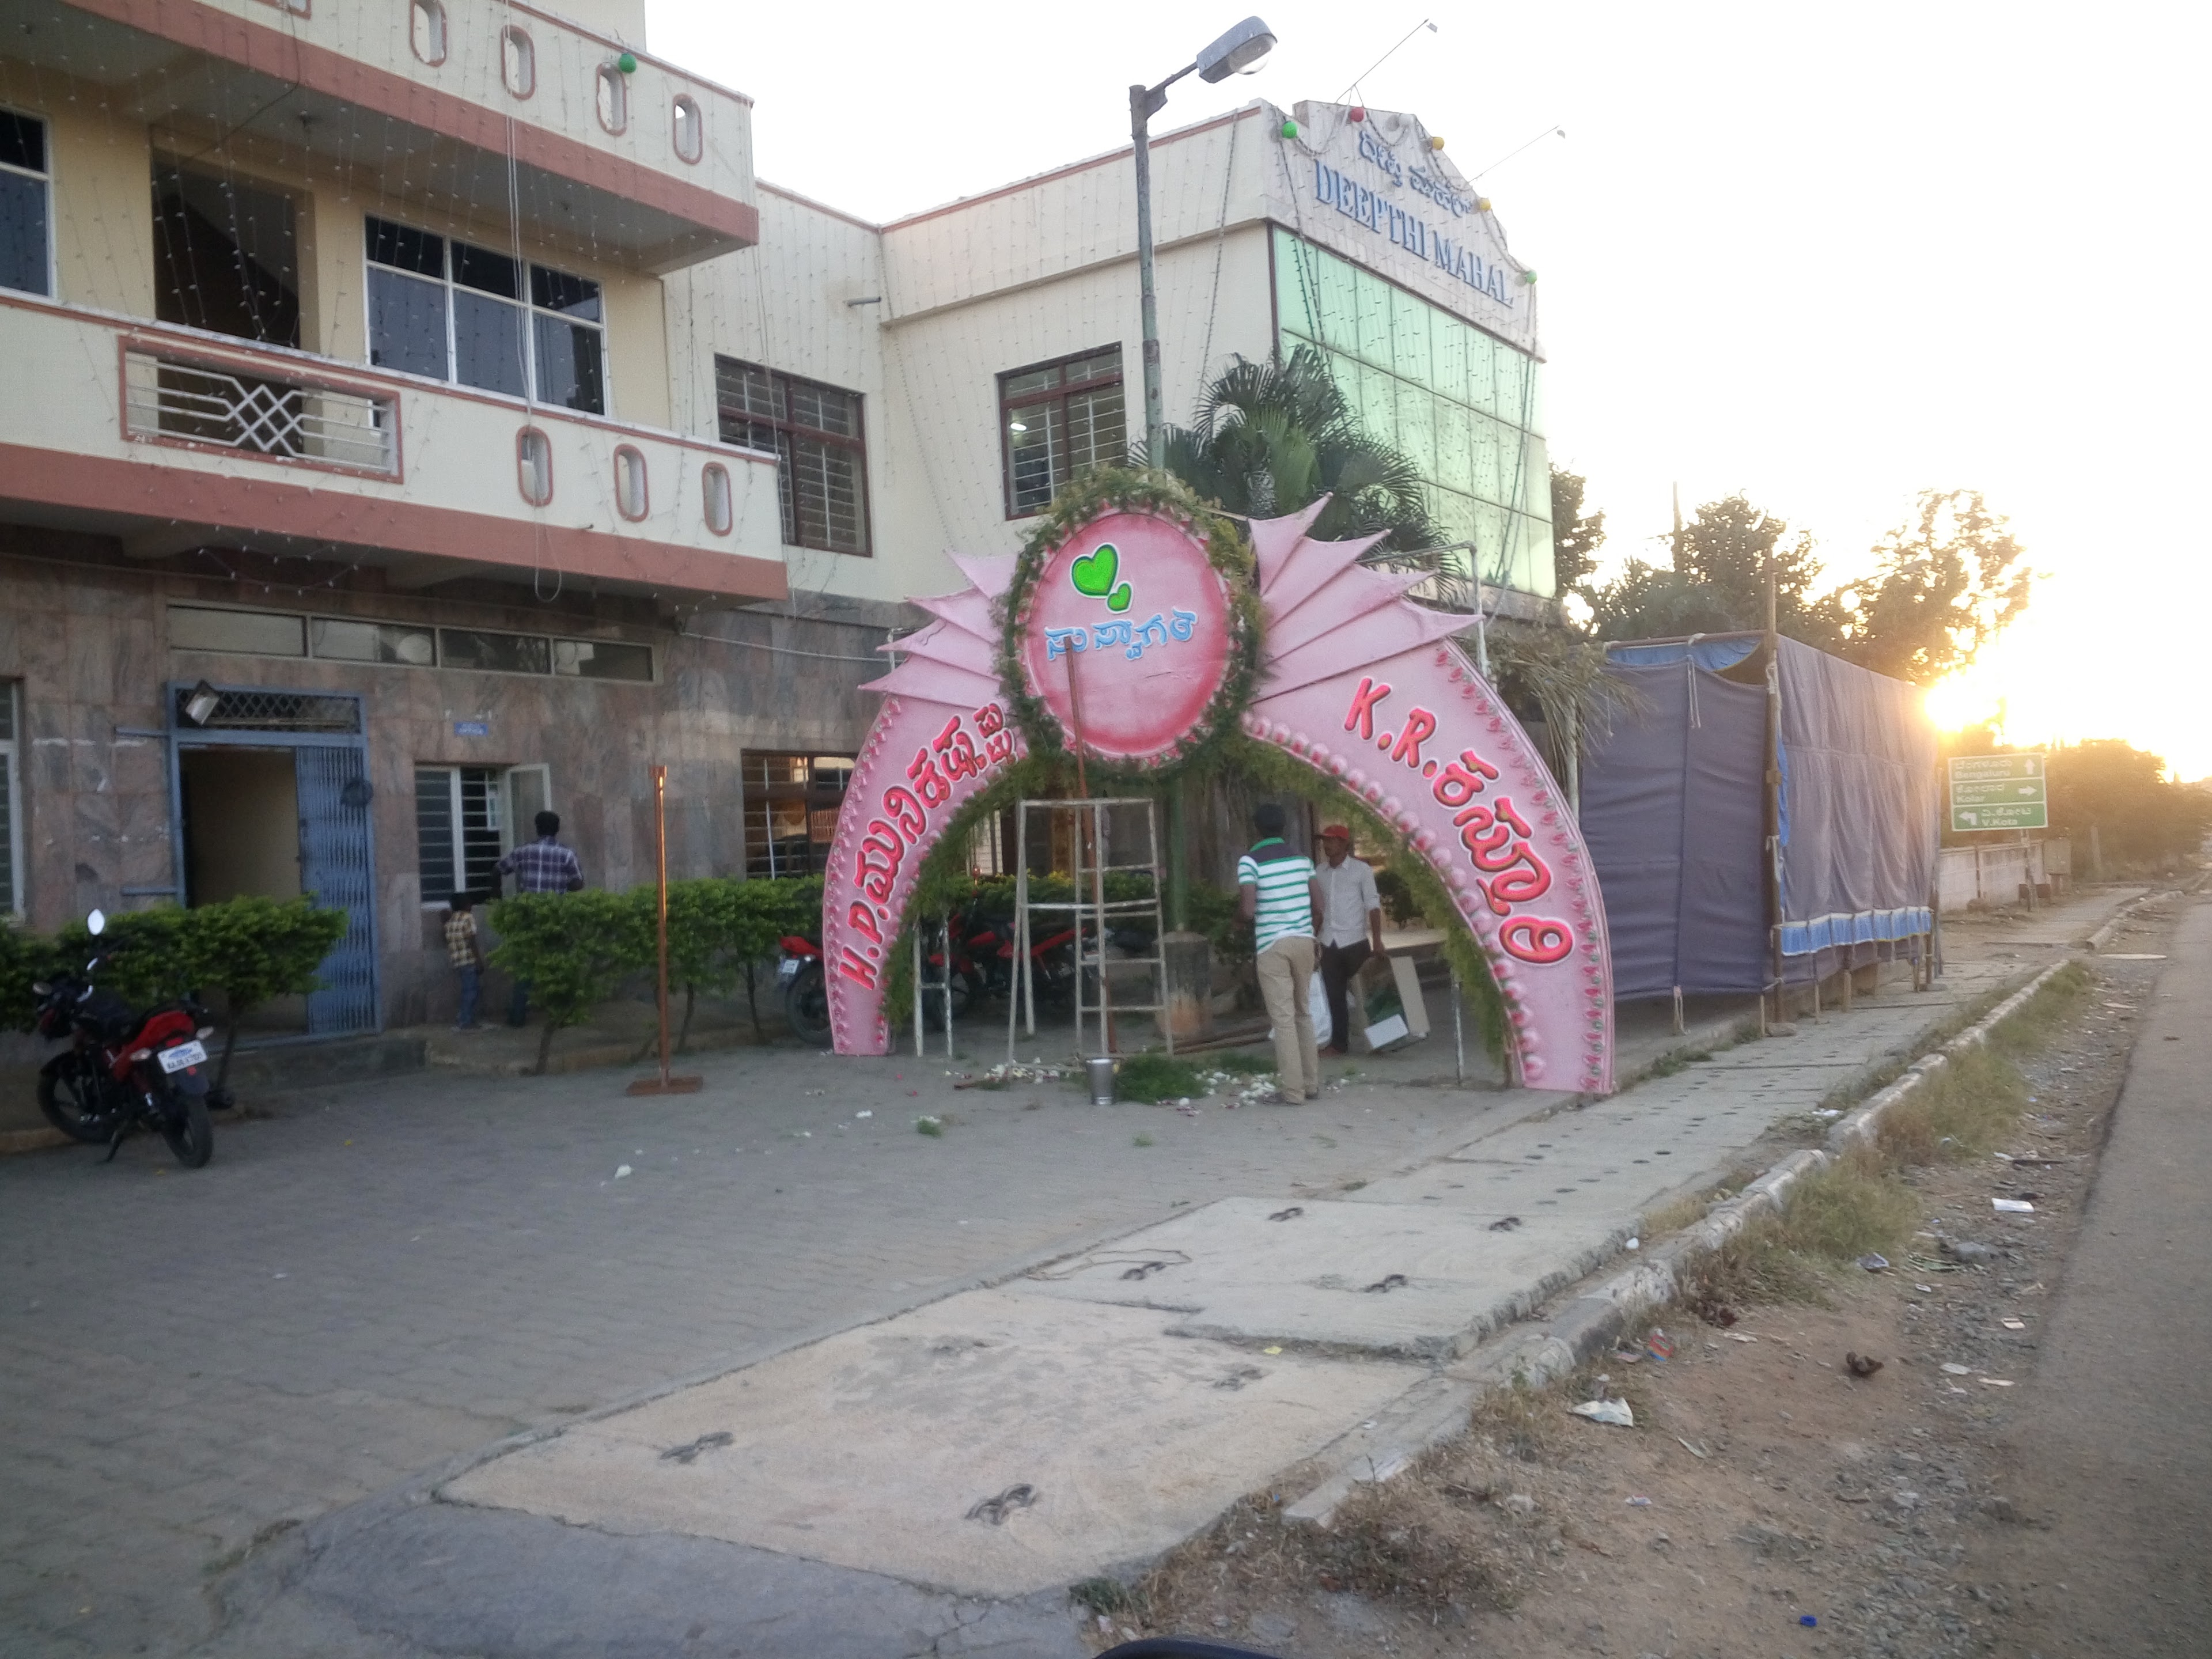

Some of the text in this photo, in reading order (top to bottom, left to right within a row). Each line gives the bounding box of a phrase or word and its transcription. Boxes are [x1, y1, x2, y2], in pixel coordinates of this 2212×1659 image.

[1315, 159, 1513, 308] DEEPTHI MAHAL
[1954, 771, 2011, 779] Bengaluru
[1956, 795, 1985, 803] Kolar
[1982, 818, 2018, 826] V.Kota
